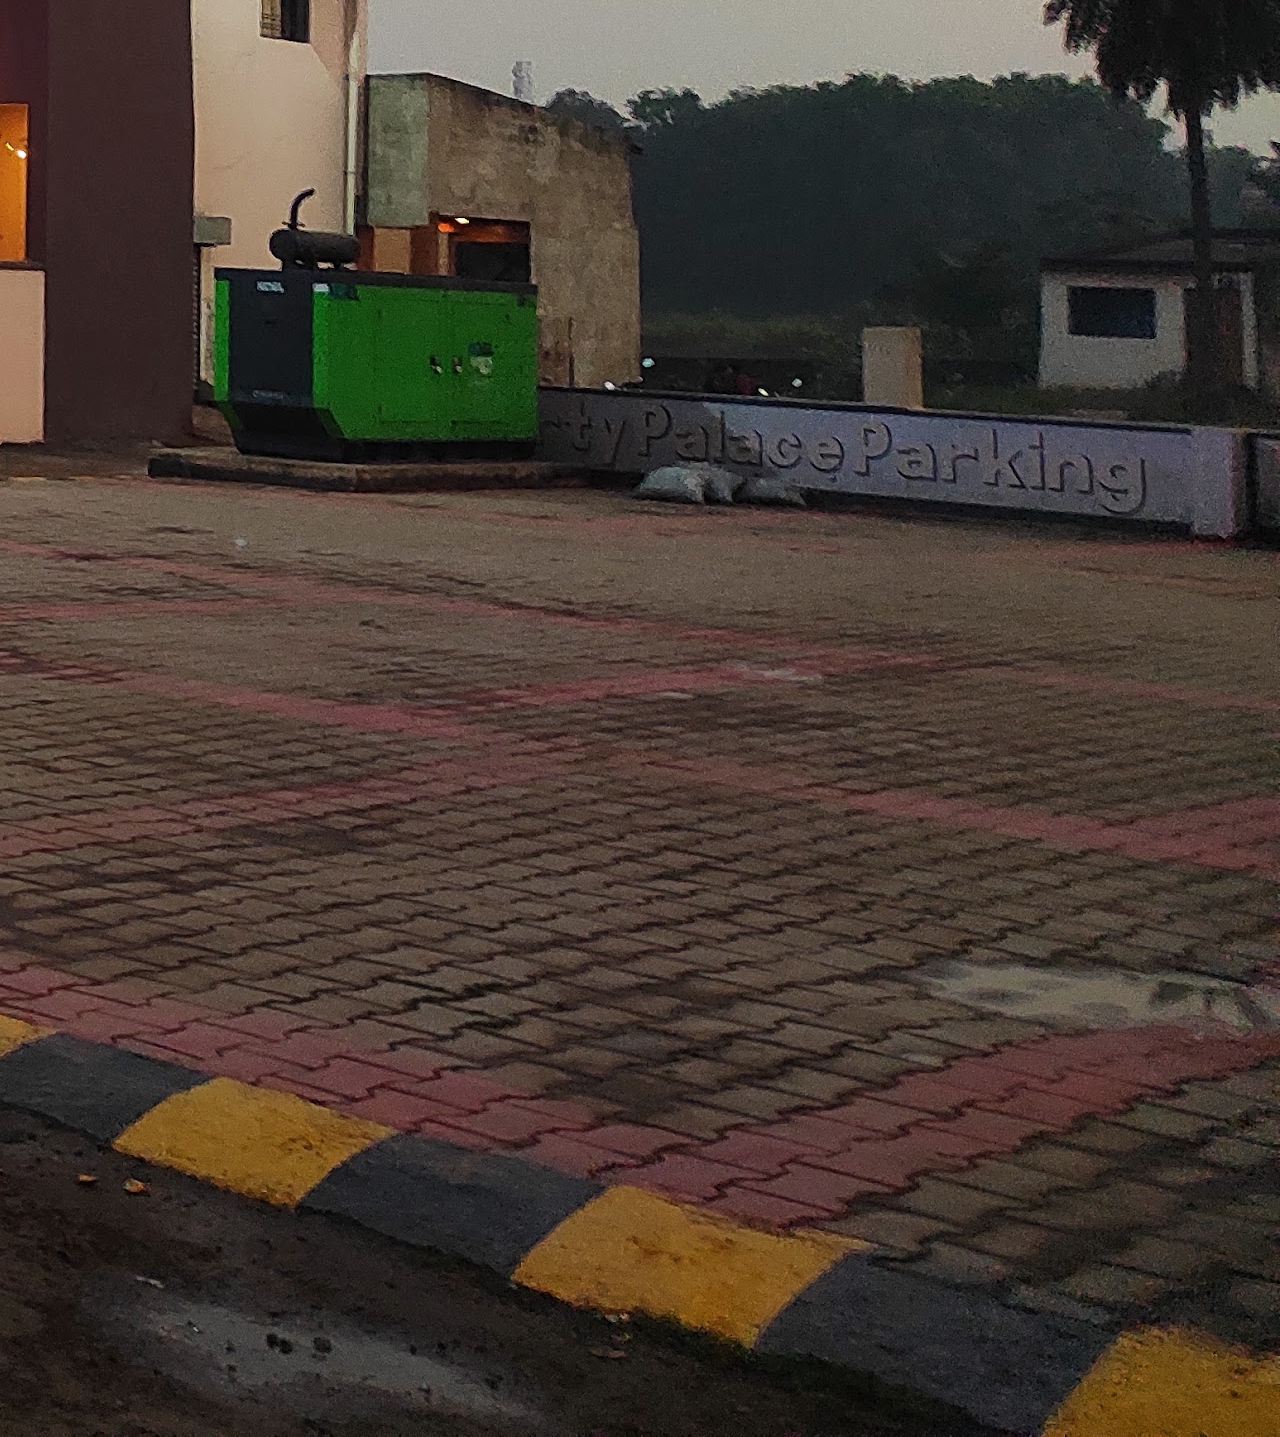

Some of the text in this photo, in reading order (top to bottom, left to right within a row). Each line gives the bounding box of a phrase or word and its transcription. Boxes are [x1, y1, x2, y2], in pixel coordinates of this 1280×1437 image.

[539, 399, 1148, 516] rty Palace Parking
